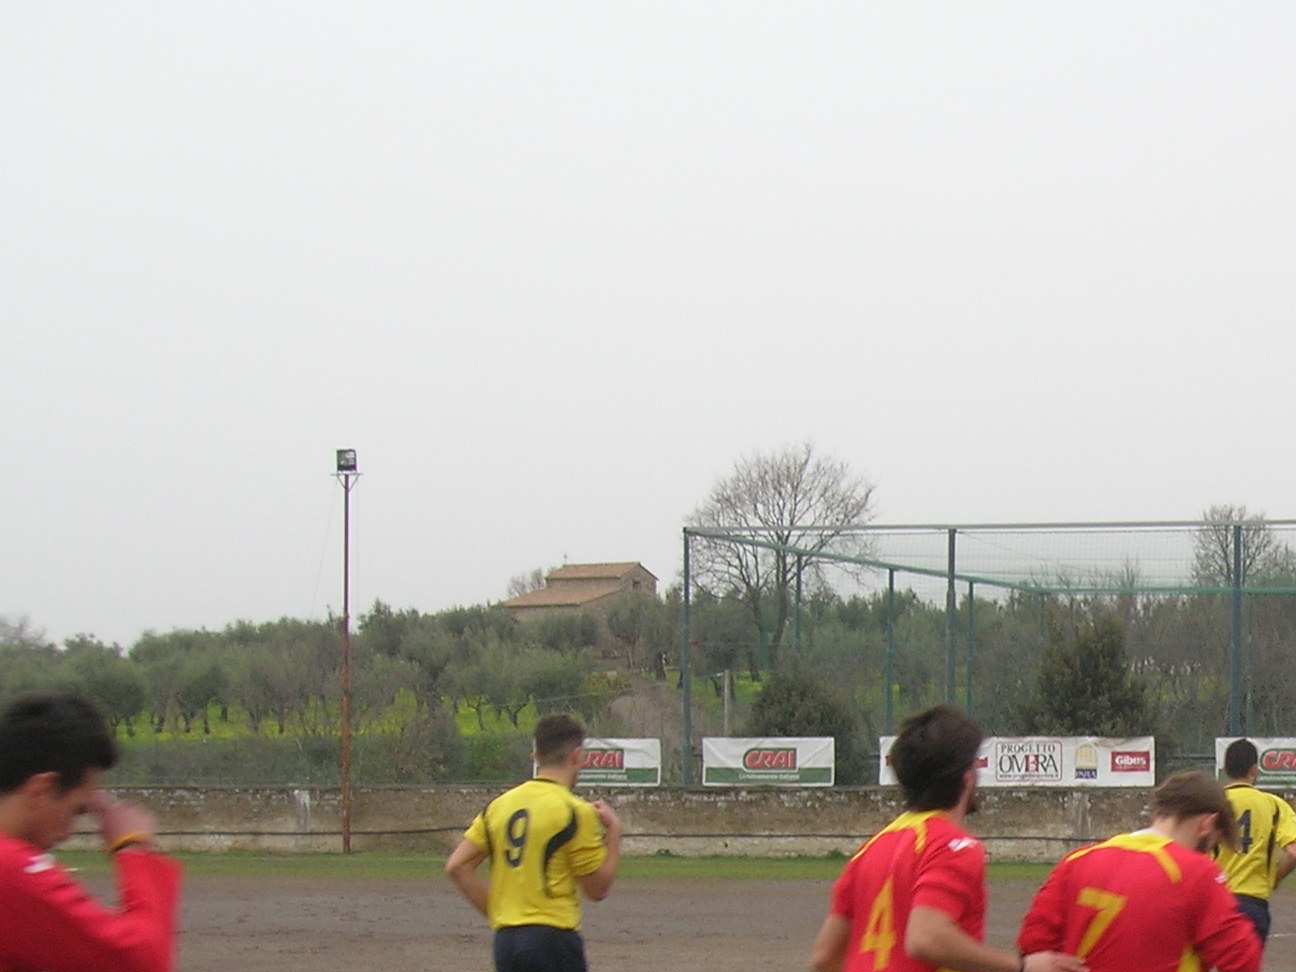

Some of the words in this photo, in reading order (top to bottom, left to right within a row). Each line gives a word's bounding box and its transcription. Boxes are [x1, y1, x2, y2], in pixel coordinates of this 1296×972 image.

[745, 750, 795, 768] CRAI
[999, 754, 1058, 773] OMBRA
[1001, 744, 1056, 753] PROGETTO
[505, 808, 529, 868] 9
[860, 876, 896, 972] 4
[1077, 888, 1128, 960] 7
